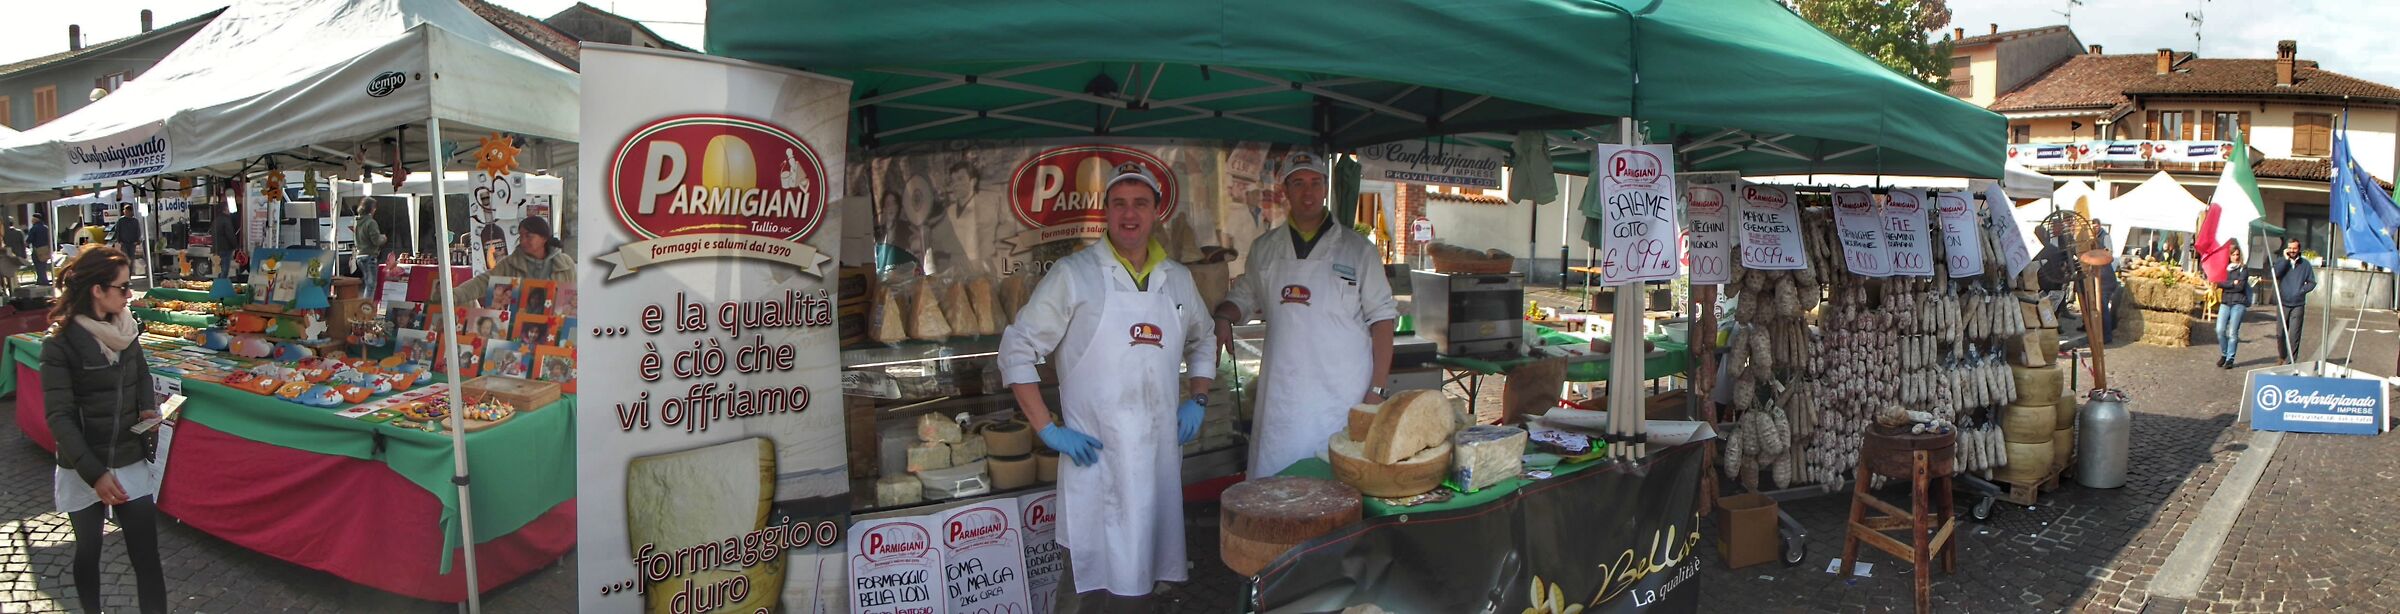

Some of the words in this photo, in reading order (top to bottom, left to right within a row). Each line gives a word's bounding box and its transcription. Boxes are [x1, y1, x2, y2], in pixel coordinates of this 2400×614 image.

[371, 74, 404, 89] tempo
[75, 136, 166, 169] Confartigianato
[129, 153, 166, 167] IMPRESE
[1386, 144, 1498, 173] Confartigianato
[638, 140, 810, 219] PARMIGIANI
[1386, 171, 1450, 183] PROVINCIA
[1470, 178, 1496, 186] LODI
[1452, 168, 1496, 178] IMPRESE
[1608, 191, 1670, 222] SALAME
[751, 221, 779, 233] Tullio
[1613, 221, 1648, 238] COTTO
[651, 239, 702, 258] formaggi
[713, 238, 749, 251] salumi
[749, 240, 766, 253] dal
[767, 244, 792, 257] 1970
[640, 303, 663, 333] e
[674, 291, 708, 331] la
[717, 289, 833, 338] qualità
[639, 342, 662, 381] è
[672, 338, 726, 379] ciò
[735, 334, 795, 373] che
[616, 391, 650, 431] vi
[660, 381, 810, 433] offriamo
[2285, 389, 2376, 410] Confartigianato
[2337, 407, 2373, 415] IMPRESE
[815, 520, 838, 547] o
[949, 520, 1002, 542] PARMIGIANI
[870, 533, 924, 555] PARMIGIANI
[857, 569, 929, 590] FORMAGGIO
[945, 557, 984, 582] TOMA
[669, 574, 750, 614] duro
[949, 582, 963, 599] DI
[967, 566, 1015, 593] MALGA
[1631, 588, 1657, 607] La
[1659, 561, 1694, 601] qualità
[859, 588, 897, 608] BELLA
[899, 585, 930, 603] LODI
